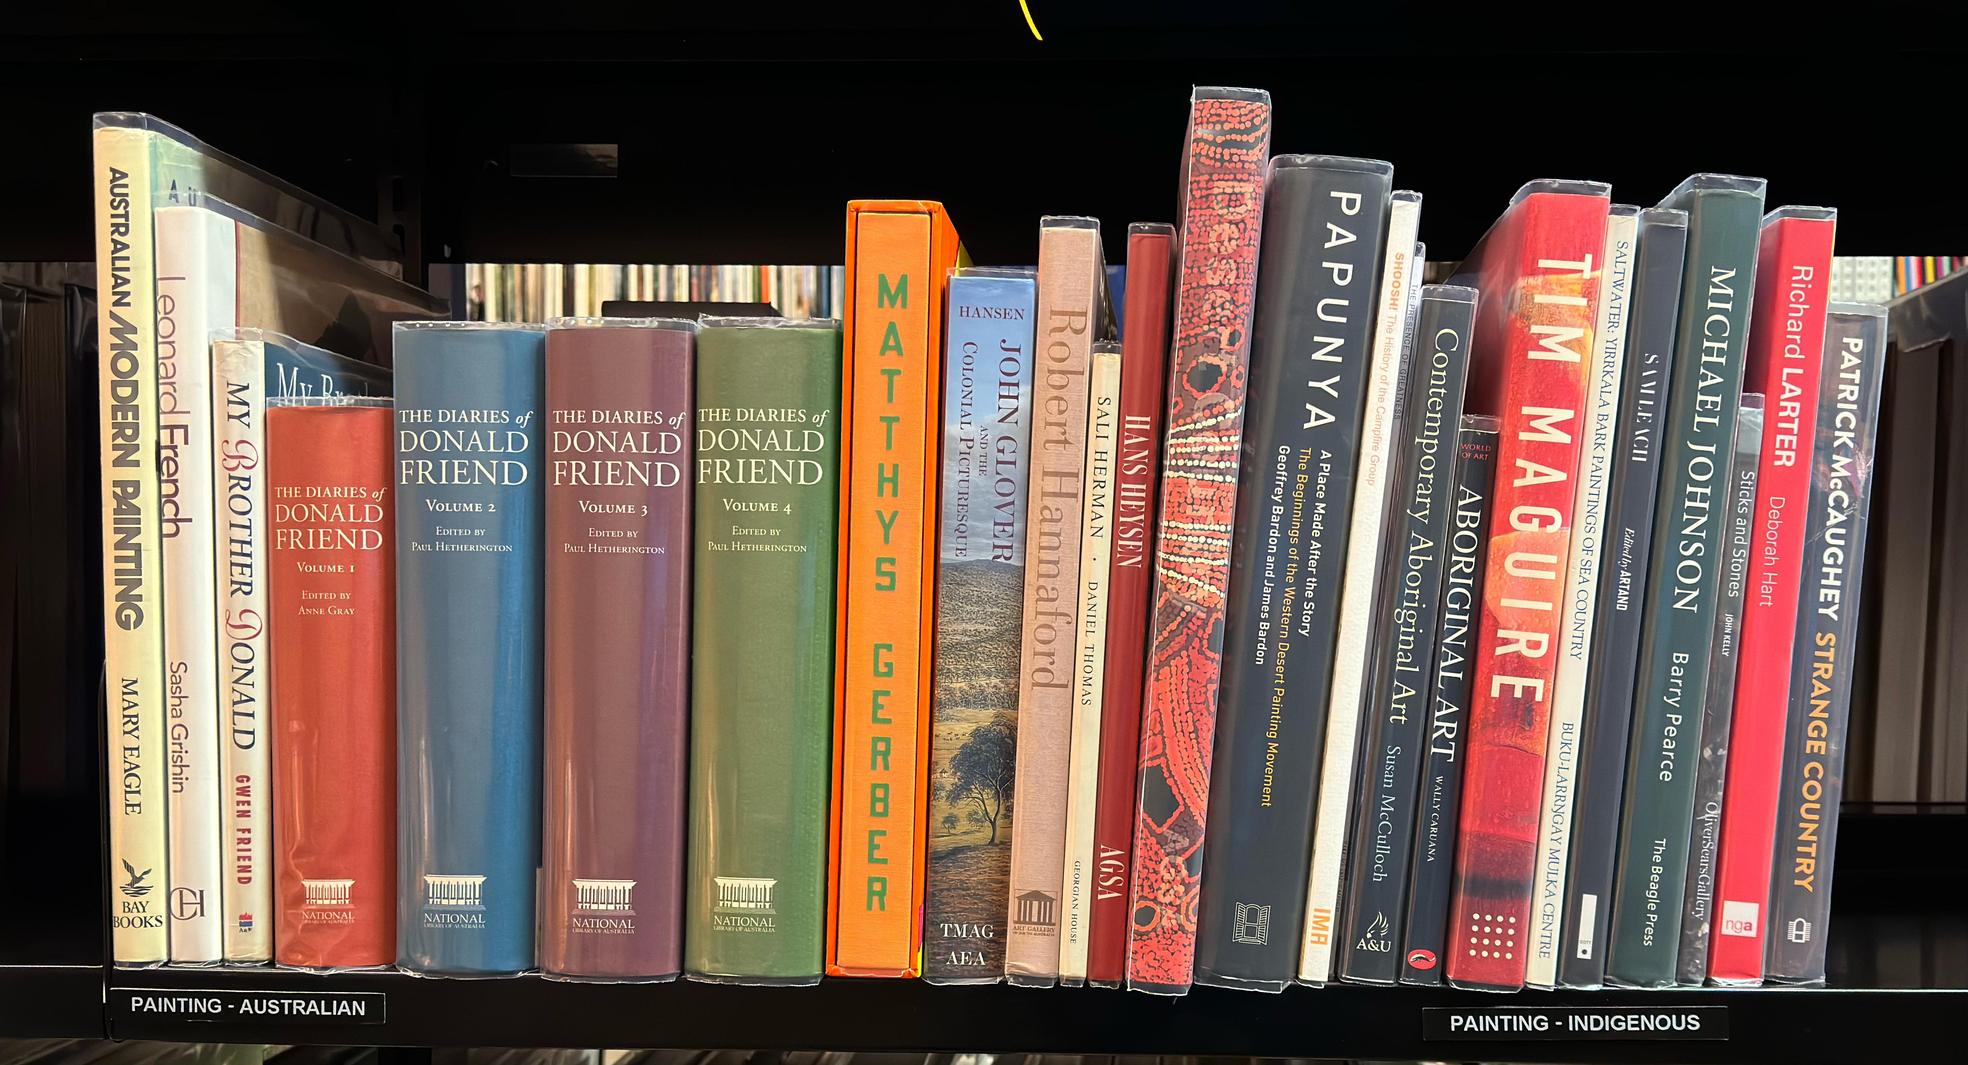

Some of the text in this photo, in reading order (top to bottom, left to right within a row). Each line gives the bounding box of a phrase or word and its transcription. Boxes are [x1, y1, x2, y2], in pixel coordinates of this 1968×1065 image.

[959, 305, 1025, 320] HANSEN
[1303, 190, 1362, 430] PAPUNYA
[1393, 284, 1419, 420] THE PRESENCE OF GREATNESS
[109, 166, 144, 631] AUSTRALIAN MODERN PAINTING
[156, 277, 193, 539] Leonard French
[399, 410, 533, 428] THE DIARIES of
[699, 409, 829, 427] THE DIARIES of
[1367, 252, 1405, 486] SHOOSH! The History of the Campfire Group
[1631, 353, 1659, 462] SAM LEACH
[1773, 264, 1813, 467] Richard LARTER
[400, 430, 529, 453] DONALD
[400, 460, 528, 485] FRIEND
[698, 459, 823, 485] FRIEND
[699, 429, 824, 452] DONALD
[979, 426, 989, 476] AND THE
[992, 338, 1021, 561] JOHN GLOVER
[1089, 397, 1111, 538] SALI HERMAN
[1117, 414, 1150, 568] HANS HEYSEN
[1460, 444, 1491, 452] WORLD
[1473, 453, 1489, 461] ART
[1491, 253, 1592, 702] TIM MAGUIRE
[1570, 241, 1629, 660] SALTWATER: YIRRKALA BARK PAINTINGS OF SEA COUNTRY
[1675, 265, 1736, 612] MICHAEL JOHNSON
[275, 504, 383, 523] DONALD
[276, 529, 383, 550] FRIEND
[783, 503, 791, 515] 4
[1031, 306, 1088, 690] Robert Hannaford
[1298, 450, 1332, 637] A Place Made After the Story
[1390, 328, 1460, 725] Contemporary Aboriginal Art
[1728, 471, 1755, 598] Sticks and Stones
[1760, 496, 1786, 608] Deborah Hart
[220, 381, 263, 751] MY BROTHER DONALD
[866, 273, 908, 911] MATTHYS GERBER
[1255, 445, 1291, 665] Geoffrey Bardon and James Bardon
[1616, 528, 1635, 611] Edited by ARTAND
[1081, 582, 1098, 706] DANIEL THOMAS
[1262, 448, 1312, 807] The Beginnings of the Western Desert Painting Movement
[1430, 484, 1483, 763] ABORIGINAL ART
[1721, 613, 1734, 656] JOHN KELLY
[1793, 337, 1864, 893] PATRICK McCAUGHEY STRANGE COUNTRY
[121, 677, 142, 816] MARY EAGLE
[170, 661, 190, 794] Sasha Grishin
[1659, 652, 1690, 782] Barry Pearce
[235, 774, 252, 885] GWEN FRIEND
[1372, 745, 1401, 883] Susan McCulloch
[1427, 775, 1444, 862] WALLY CARUANA
[113, 914, 163, 929] BOOKS
[122, 900, 149, 914] BAY
[714, 915, 775, 927] NATIONAL
[1070, 860, 1081, 944] GEORGIAN HOUSE
[1097, 845, 1125, 900] AGSA
[1544, 848, 1563, 898] MULKA
[1644, 838, 1666, 947] The Beagle Press
[1725, 919, 1753, 933] nga
[941, 923, 994, 939] TMAG
[947, 951, 985, 966] AEA
[1356, 938, 1392, 953] A&U
[1538, 902, 1555, 959] CENTRE
[131, 996, 366, 1017] PAINTING AUSTRALIAN
[1450, 1014, 1701, 1031] PAINTING INDIGENOUS
